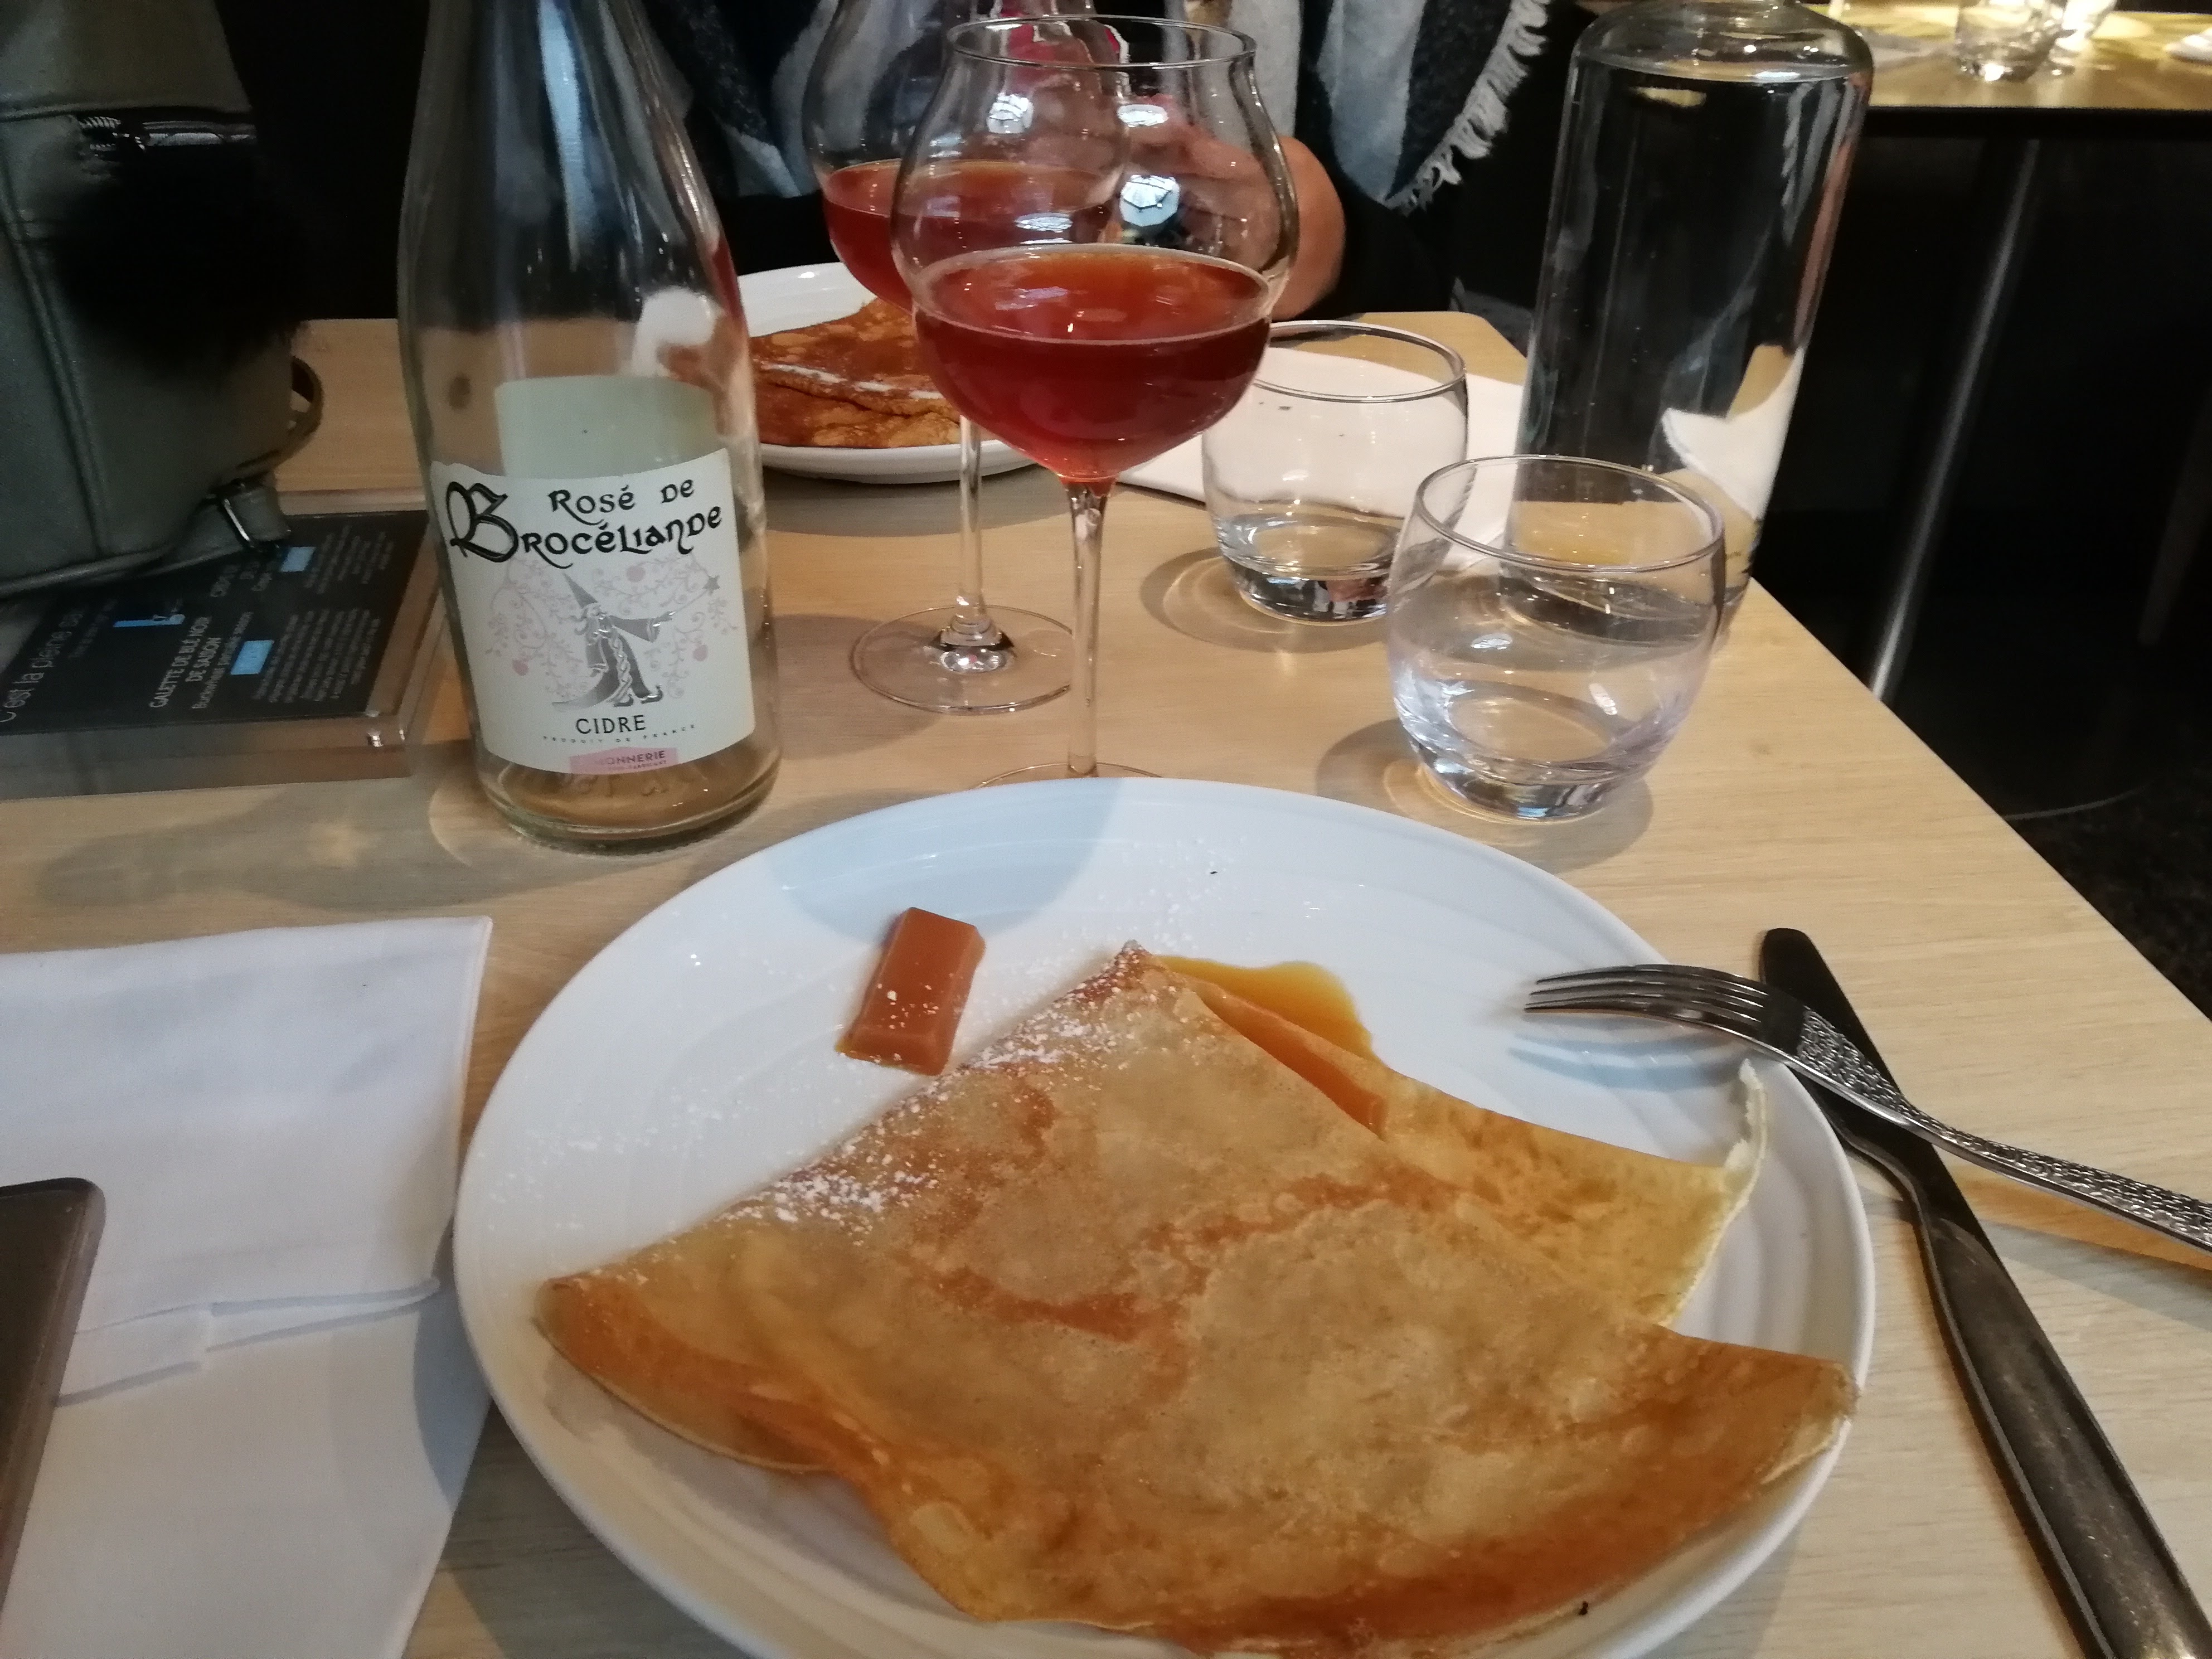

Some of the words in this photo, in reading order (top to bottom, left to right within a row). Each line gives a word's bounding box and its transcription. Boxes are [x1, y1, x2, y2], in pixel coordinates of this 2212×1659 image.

[149, 668, 185, 708] GALETTE
[185, 670, 207, 682] DE
[0, 687, 35, 722] Cest
[575, 715, 646, 734] CIDRE
